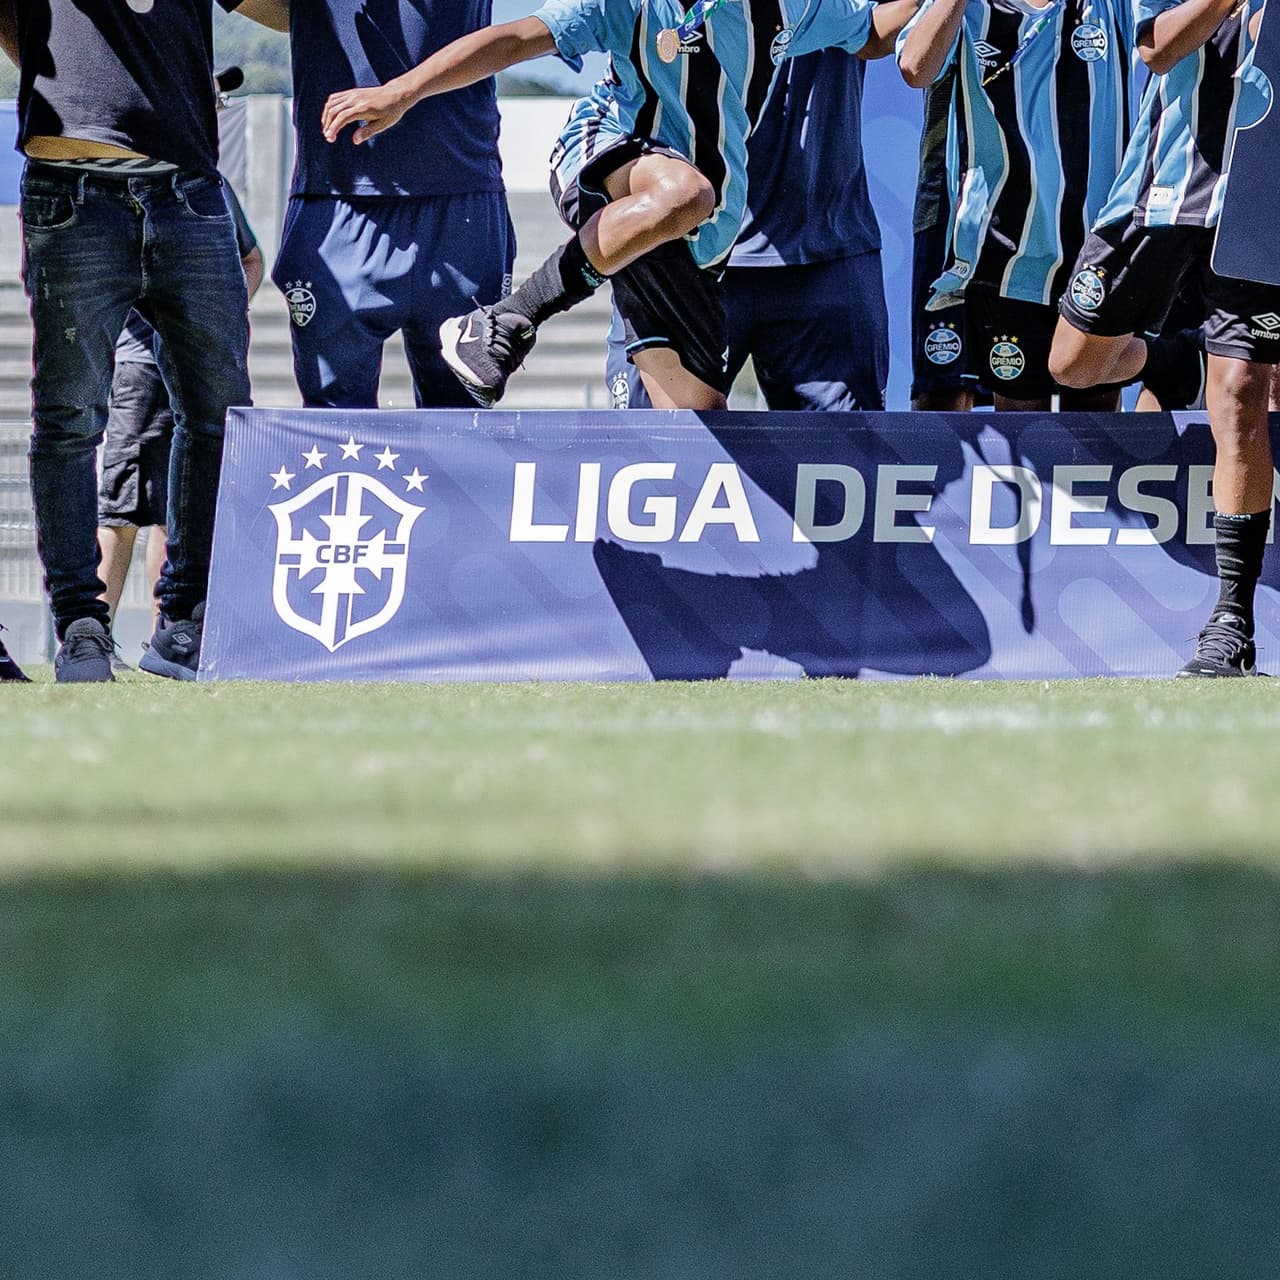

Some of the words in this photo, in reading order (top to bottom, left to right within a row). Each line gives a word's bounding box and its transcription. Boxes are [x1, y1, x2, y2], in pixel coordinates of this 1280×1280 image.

[1250, 328, 1280, 341] umbro
[508, 461, 761, 544] LIGA
[792, 463, 940, 545] DE
[316, 544, 369, 564] CBF
